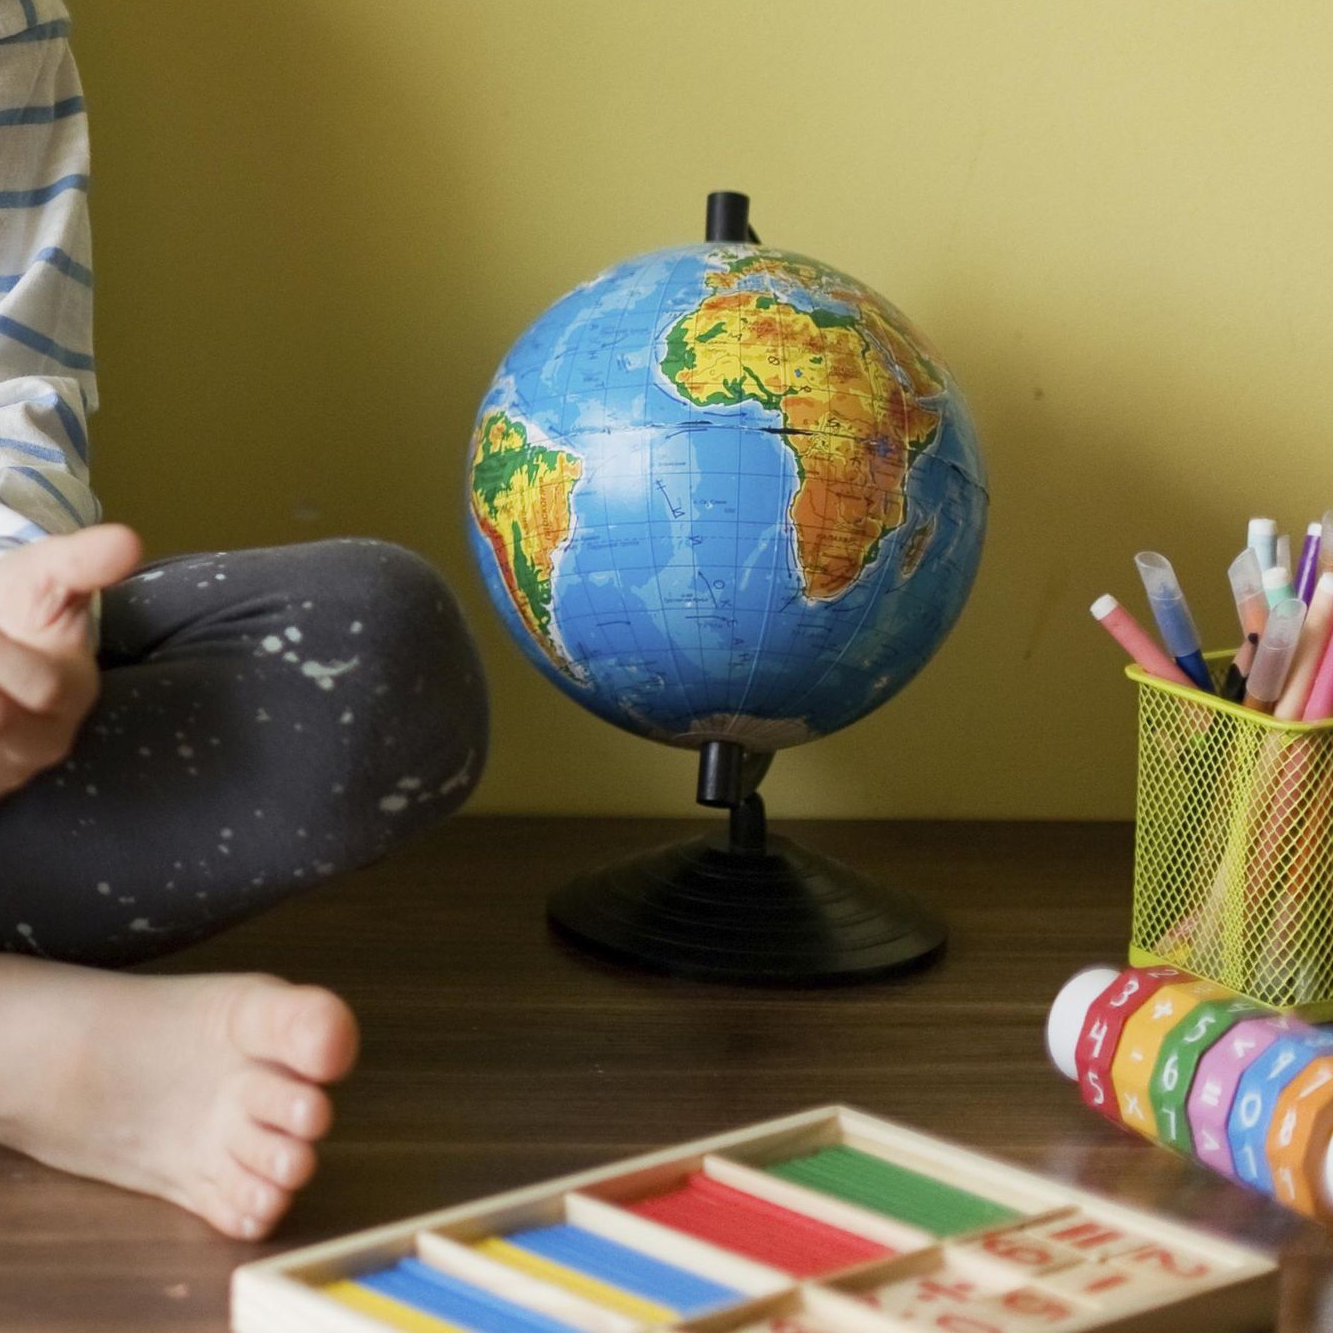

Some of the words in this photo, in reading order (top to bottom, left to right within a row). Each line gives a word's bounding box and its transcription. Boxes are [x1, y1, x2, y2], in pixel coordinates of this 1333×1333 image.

[1110, 979, 1140, 1007] 3
[1184, 1016, 1216, 1044] 5
[1086, 1071, 1105, 1105] 5
[1088, 1019, 1108, 1059] 4
[1161, 1053, 1179, 1092] 6
[1239, 1093, 1263, 1129] 0
